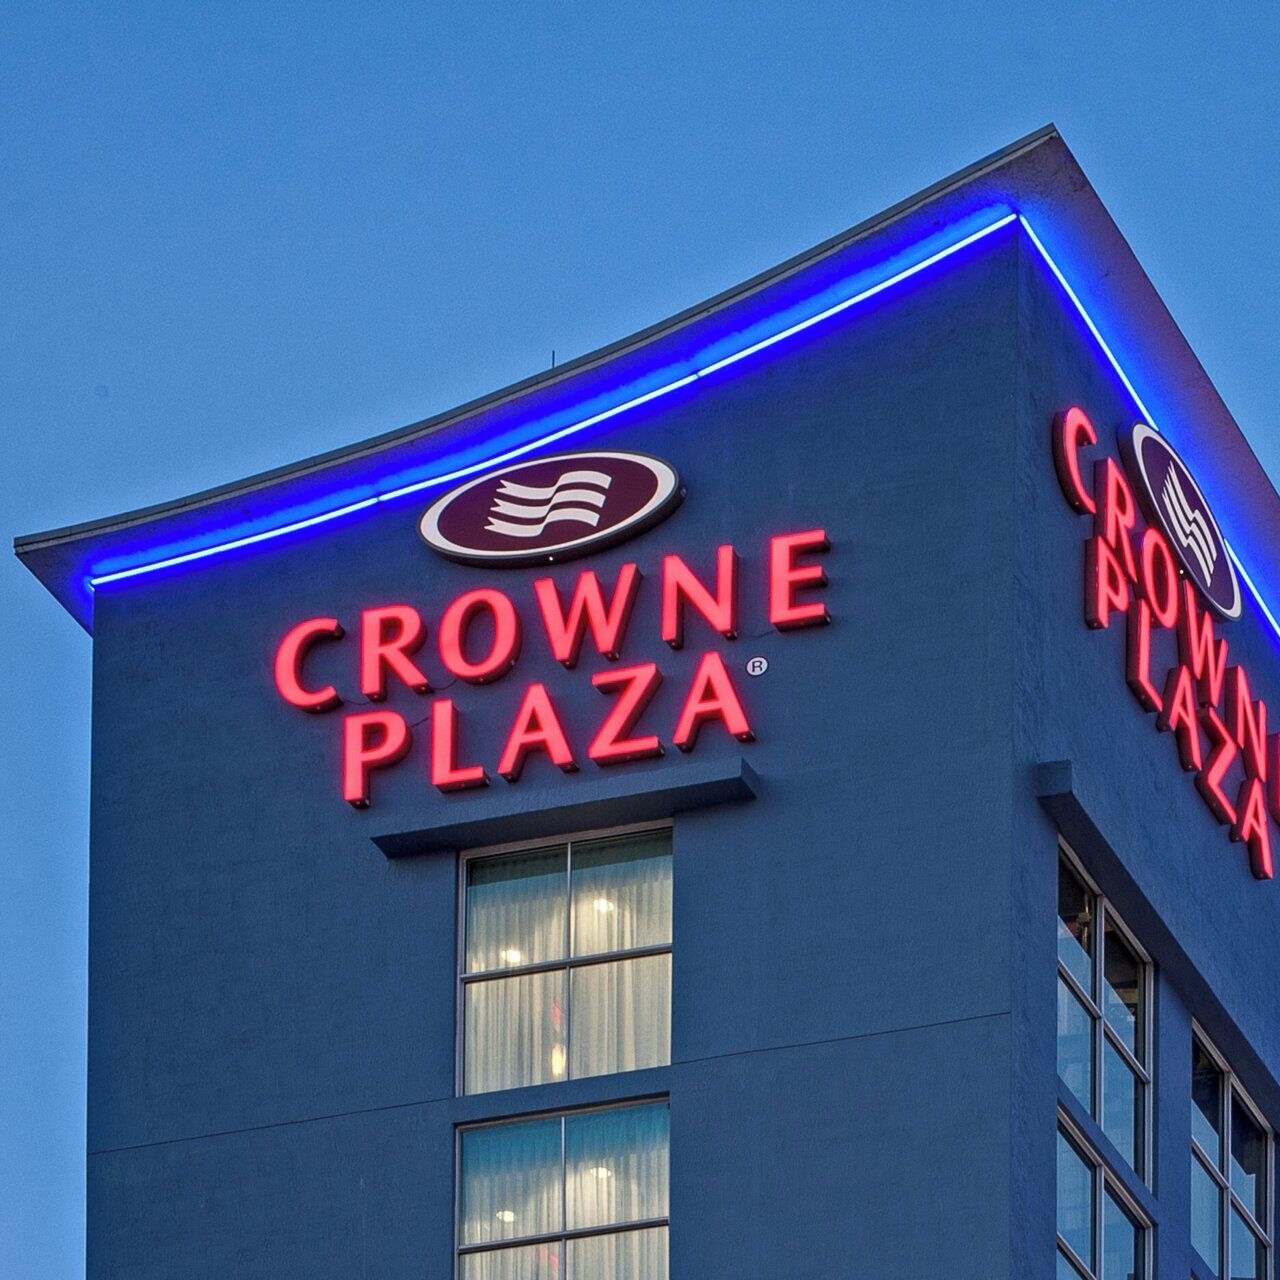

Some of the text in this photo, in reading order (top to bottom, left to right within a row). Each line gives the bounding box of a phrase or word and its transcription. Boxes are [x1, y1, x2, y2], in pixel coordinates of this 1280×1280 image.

[274, 529, 829, 710] CROWNE
[1090, 536, 1273, 879] PLAZA
[343, 651, 755, 805] PLAZA
